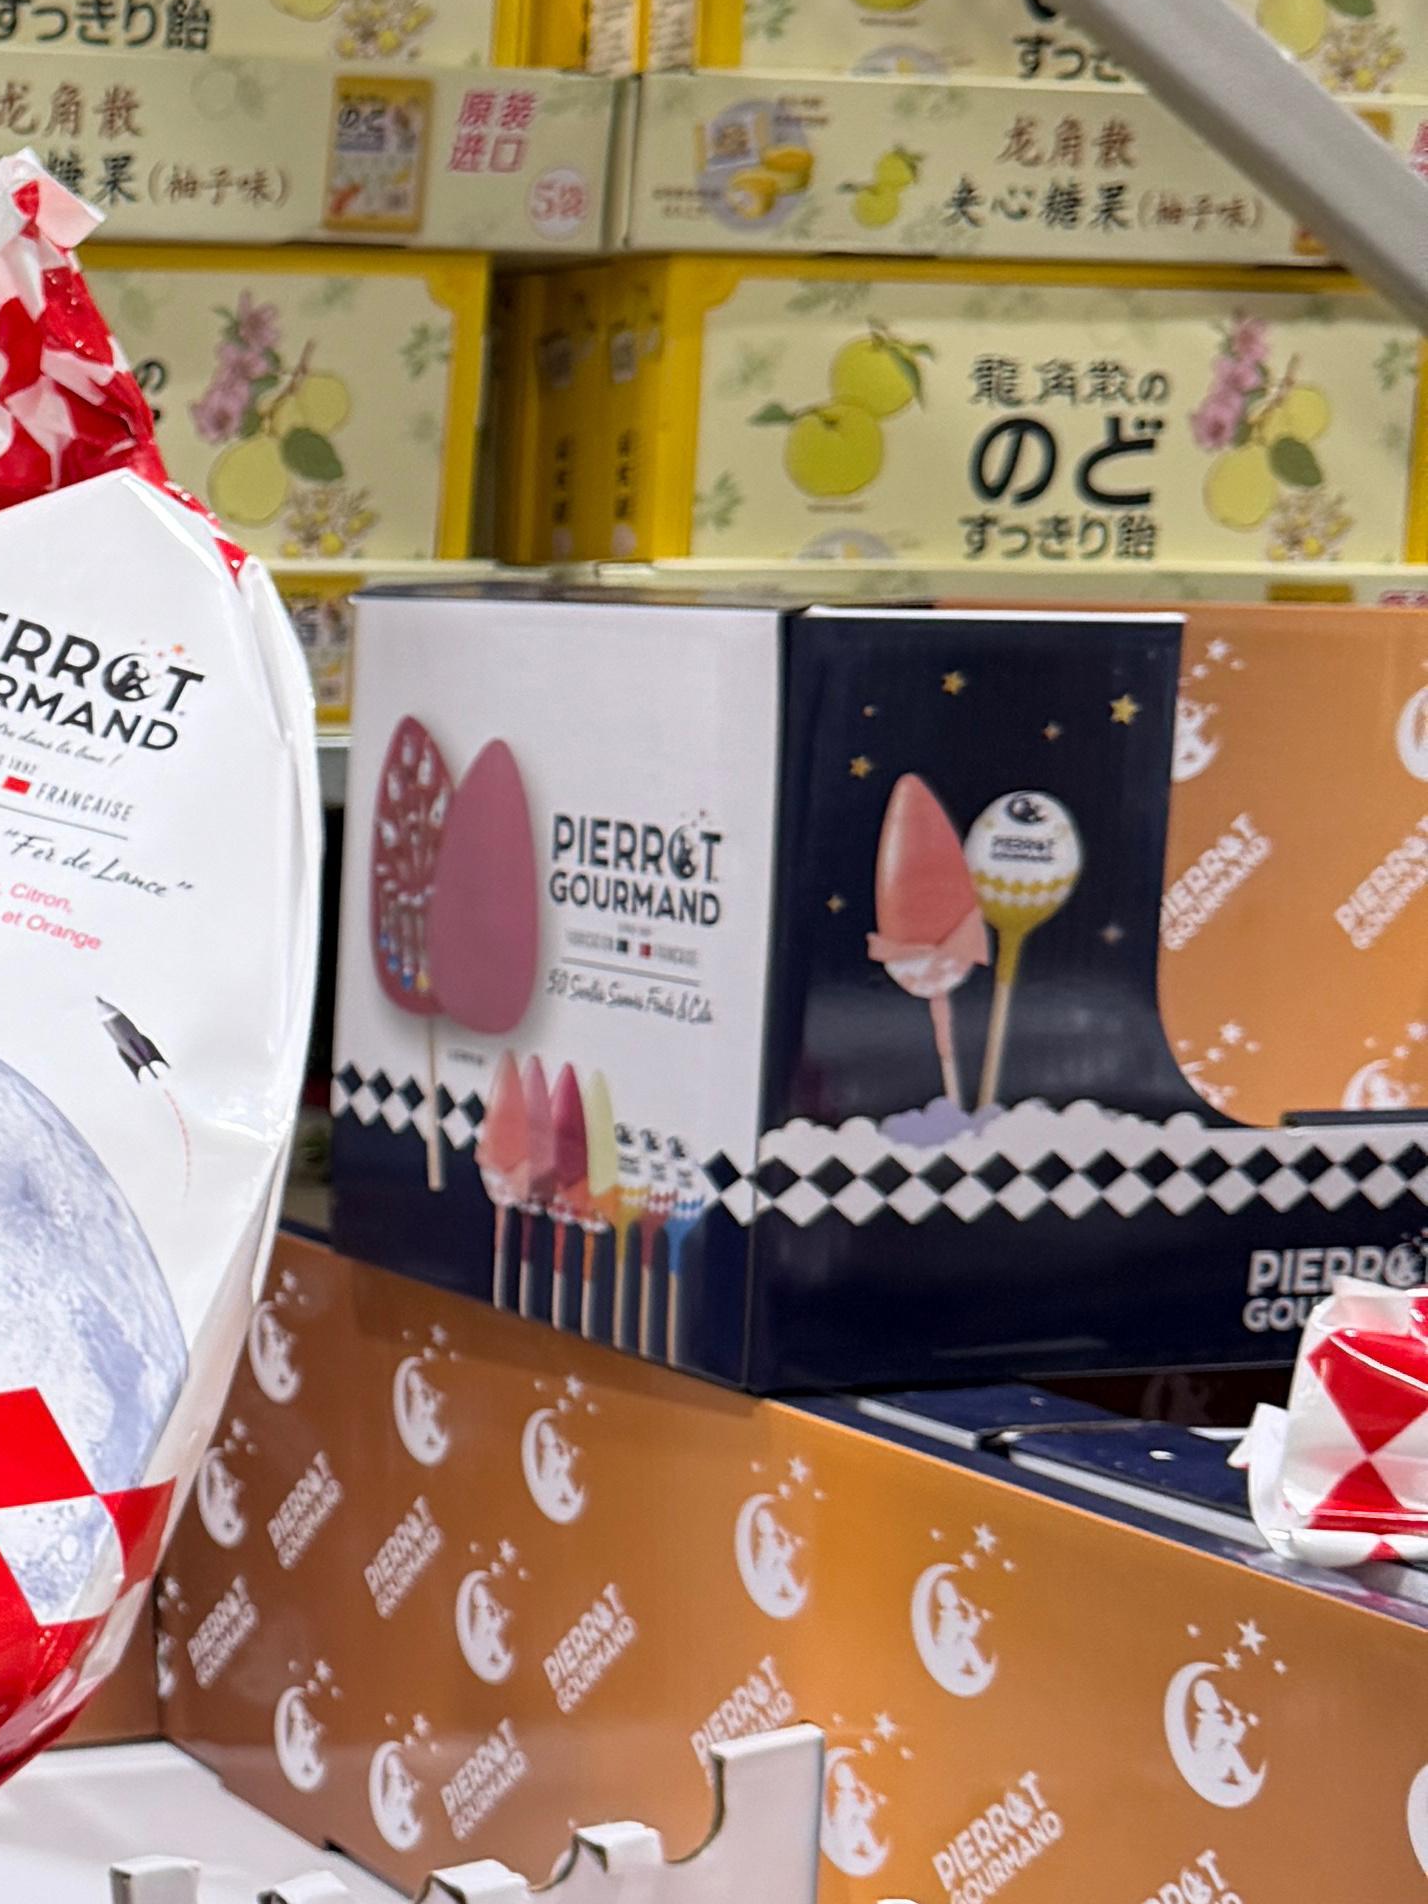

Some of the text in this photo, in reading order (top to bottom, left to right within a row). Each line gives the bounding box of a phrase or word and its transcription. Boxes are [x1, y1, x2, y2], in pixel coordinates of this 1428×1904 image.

[997, 116, 1135, 169] 龙角散
[969, 354, 1168, 407] 龍角散の
[969, 414, 1166, 509] のど
[61, 849, 91, 873] de
[551, 811, 722, 885] PIERROT
[9, 882, 74, 915] Citron,
[549, 870, 722, 927] GOURMAND
[1, 907, 22, 927] et
[26, 912, 103, 952] Orange
[1246, 1245, 1428, 1298] PIERRO
[543, 1581, 625, 1689] PIERROT
[932, 1771, 1049, 1890] PIERROT
